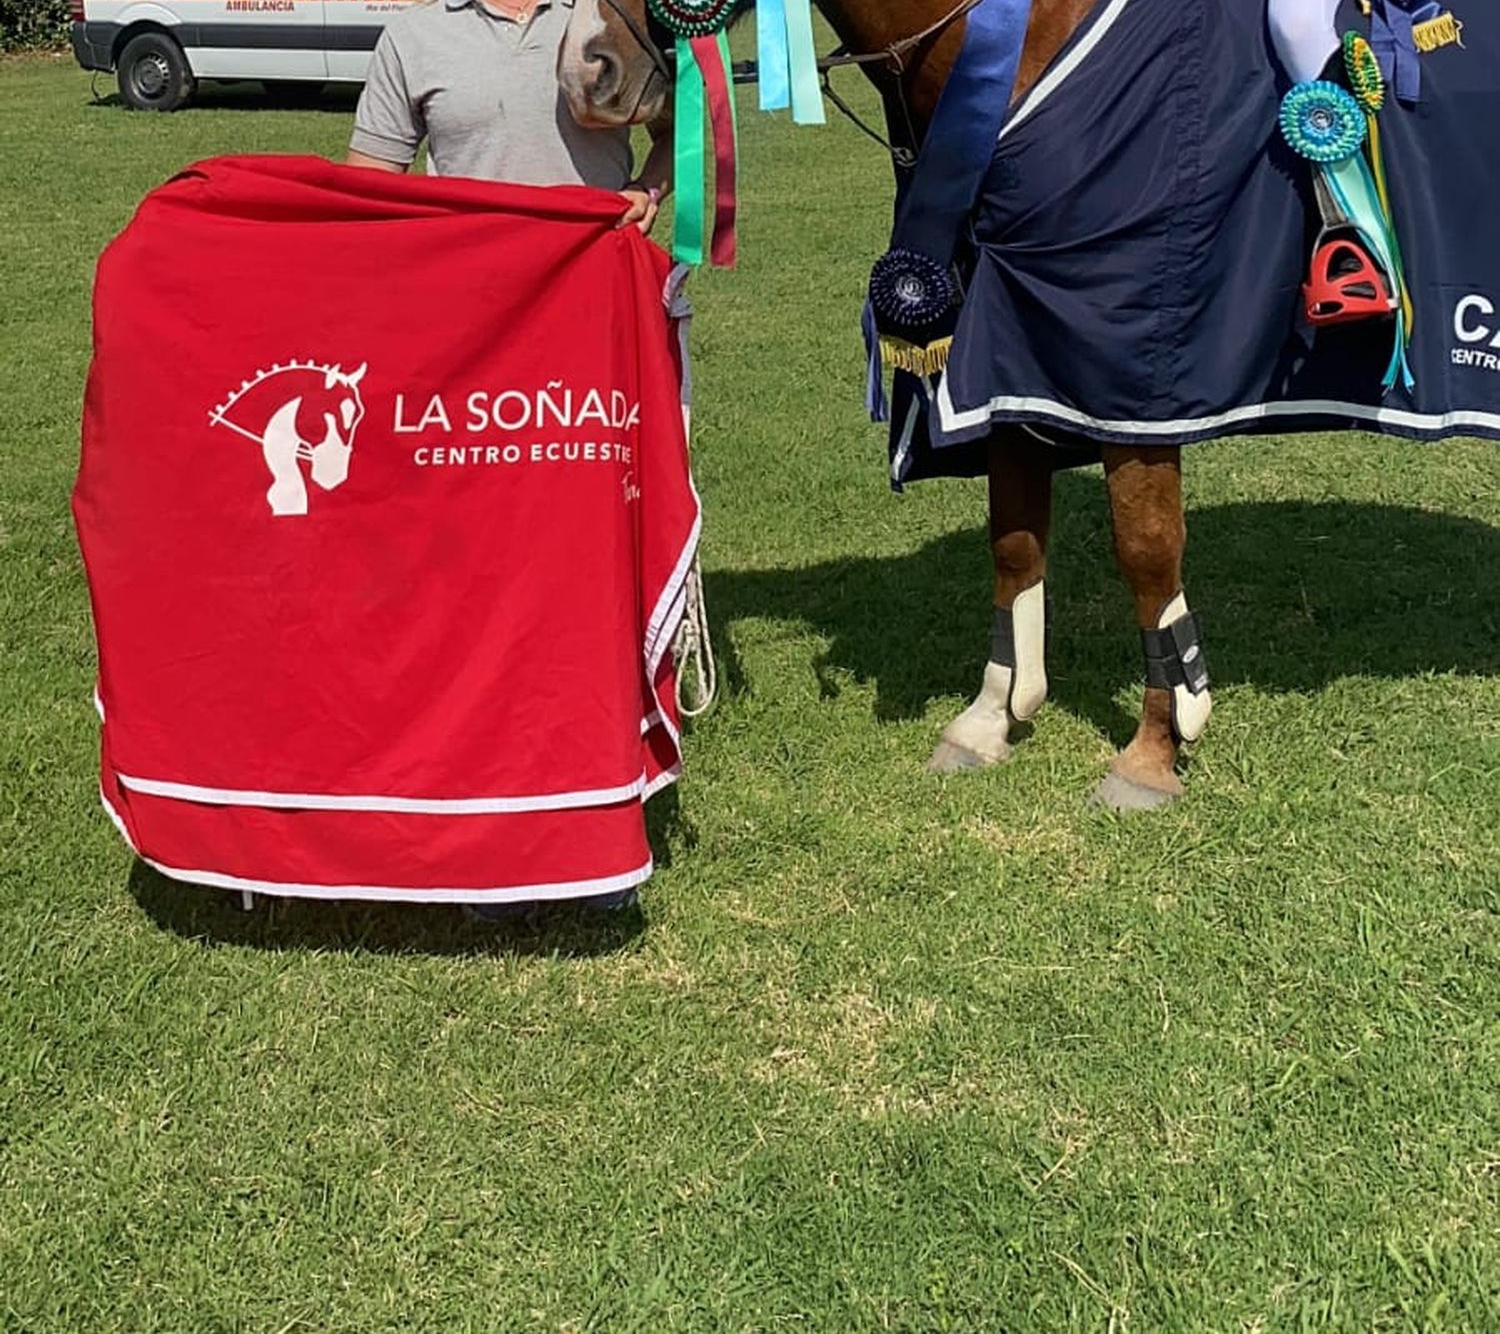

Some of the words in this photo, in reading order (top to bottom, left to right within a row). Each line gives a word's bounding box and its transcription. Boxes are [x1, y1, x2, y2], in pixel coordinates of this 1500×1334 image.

[226, 1, 294, 11] AMBULANCIA
[1453, 294, 1500, 348] C
[1451, 348, 1500, 371] CENTR
[394, 393, 452, 432] LA
[414, 445, 521, 466] CENTRO
